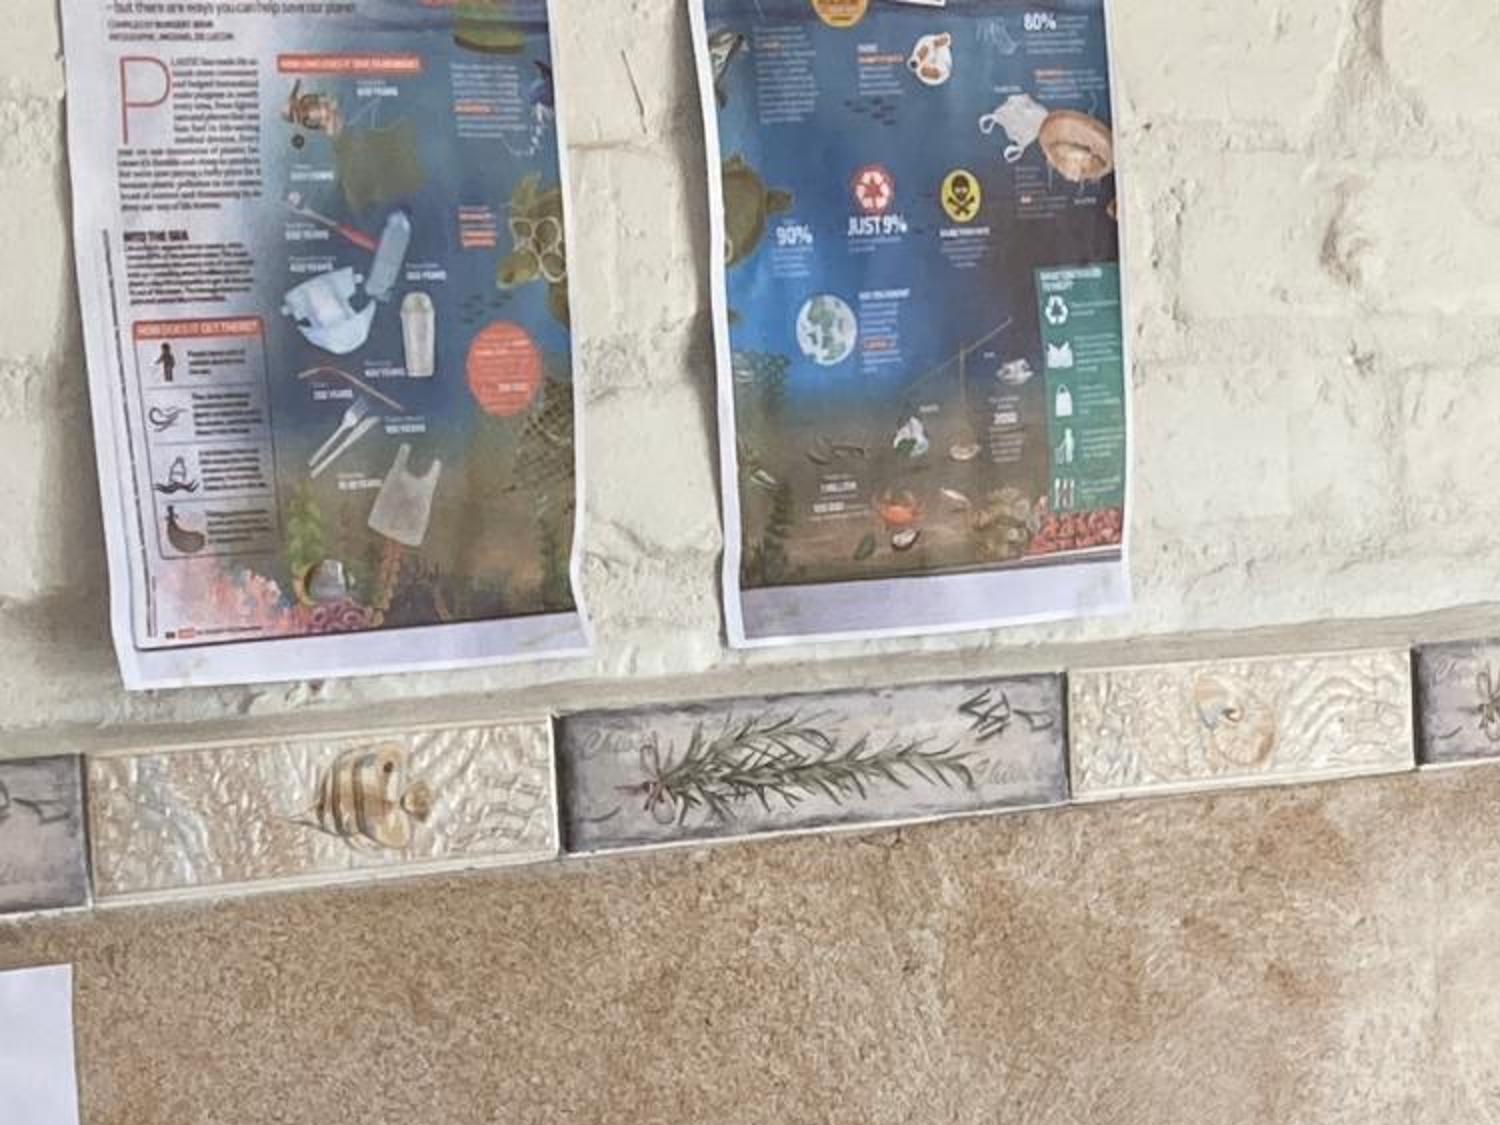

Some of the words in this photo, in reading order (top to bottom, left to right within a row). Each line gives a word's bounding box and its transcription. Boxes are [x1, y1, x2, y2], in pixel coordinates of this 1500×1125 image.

[776, 223, 813, 245] 90%
[848, 215, 881, 235] JUST
[882, 213, 908, 234] 9%
